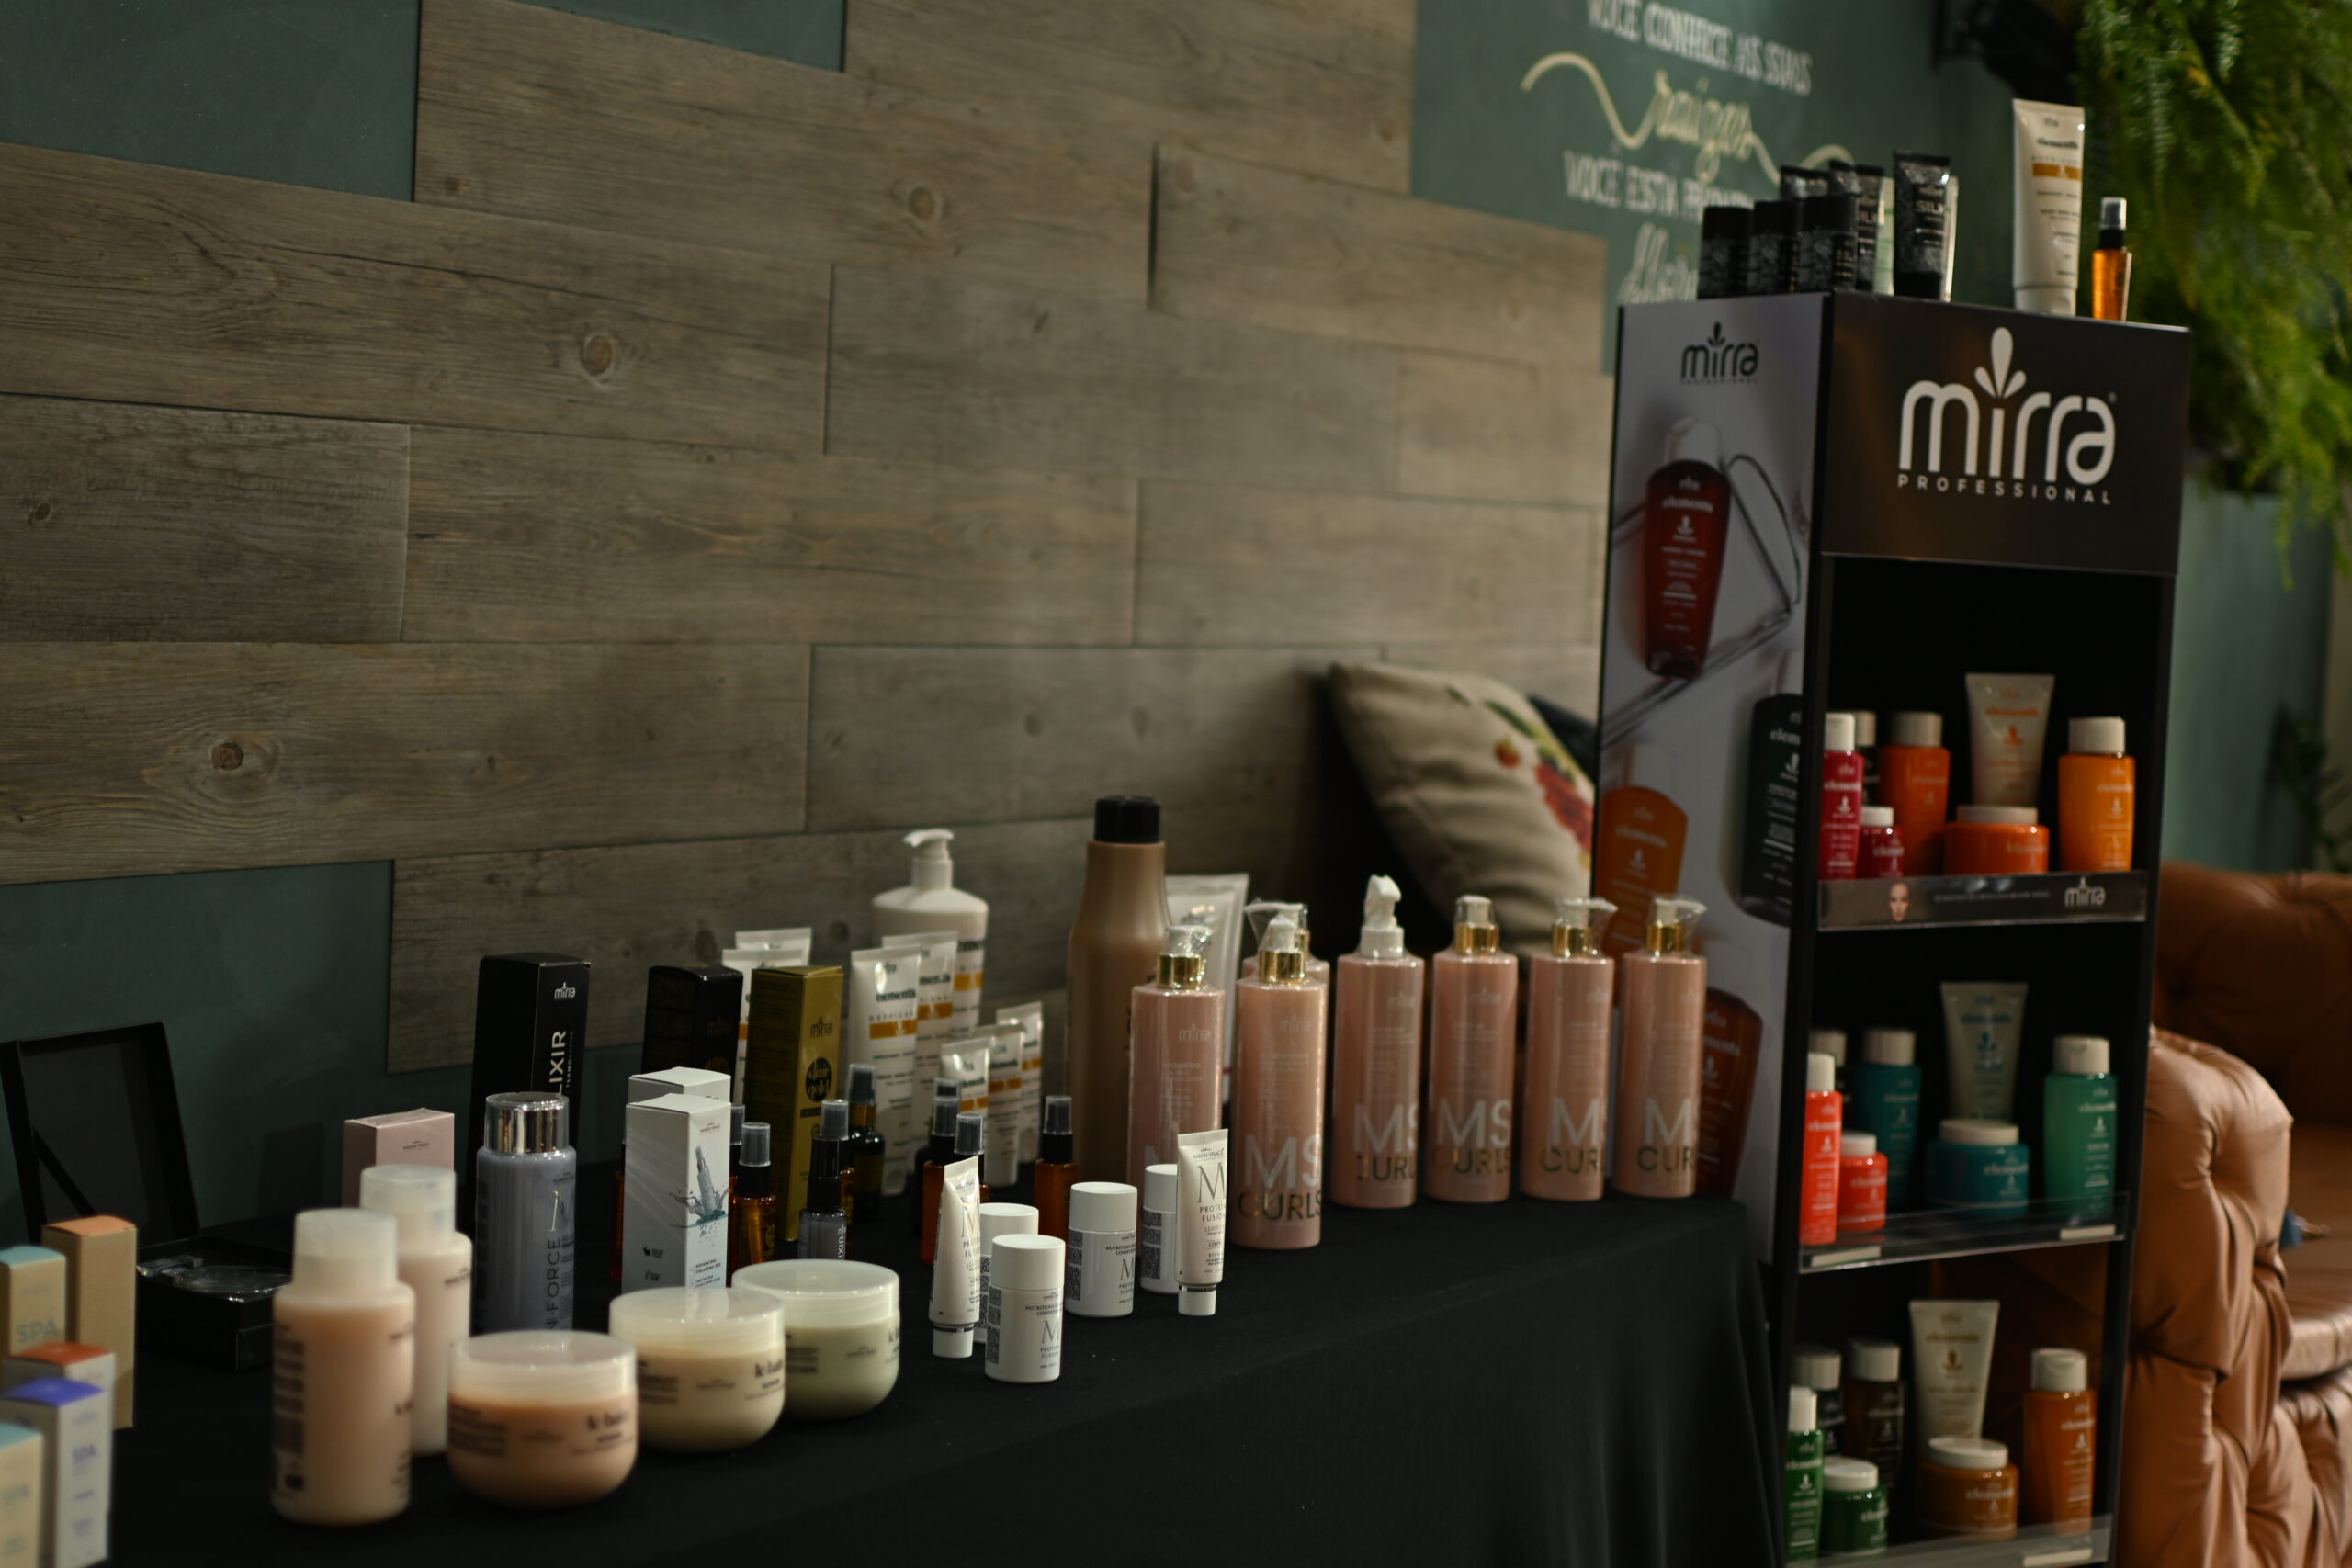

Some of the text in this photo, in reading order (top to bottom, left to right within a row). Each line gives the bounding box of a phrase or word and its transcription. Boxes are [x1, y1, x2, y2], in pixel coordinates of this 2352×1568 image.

[1680, 321, 1759, 378] mirra
[1898, 326, 2117, 486] mirra
[1897, 473, 2111, 505] PROFESSIONAL
[554, 981, 576, 1000] mirra
[549, 1031, 567, 1096] LIXIR
[1437, 1098, 1512, 1148] MS
[1244, 1134, 1322, 1189] MS
[1238, 1190, 1323, 1221] CURLS
[16, 1319, 60, 1344] SPA
